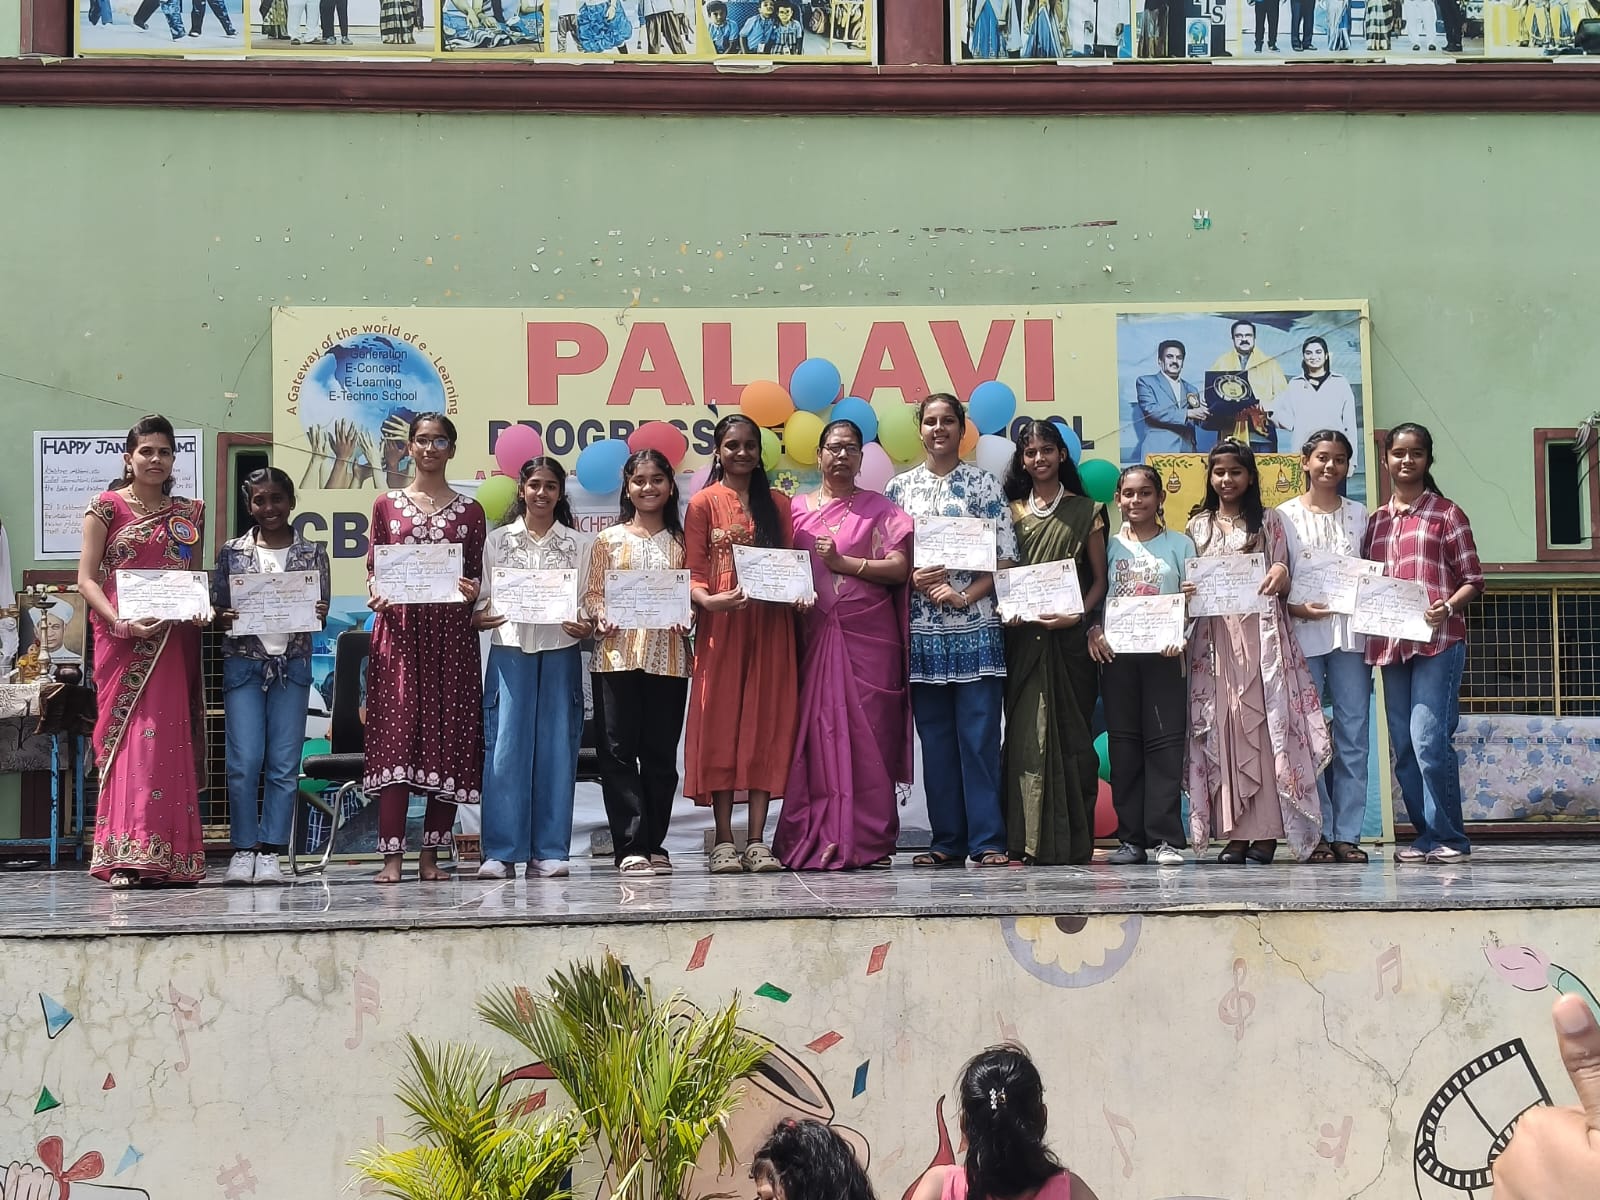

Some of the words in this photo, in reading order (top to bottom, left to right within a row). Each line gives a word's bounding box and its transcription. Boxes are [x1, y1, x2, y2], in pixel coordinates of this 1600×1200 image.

[336, 326, 358, 340] the
[362, 324, 401, 337] world
[403, 331, 419, 343] of
[321, 335, 334, 350] of
[345, 362, 401, 374] E-Concept
[526, 319, 1055, 405] PALLAVI
[288, 348, 321, 401] Gateway
[344, 376, 402, 389] E-Learning
[433, 356, 458, 415] Learning
[329, 391, 379, 401] E-Techno
[381, 390, 418, 401] School
[286, 406, 297, 415] A
[43, 440, 92, 455] HAPPY
